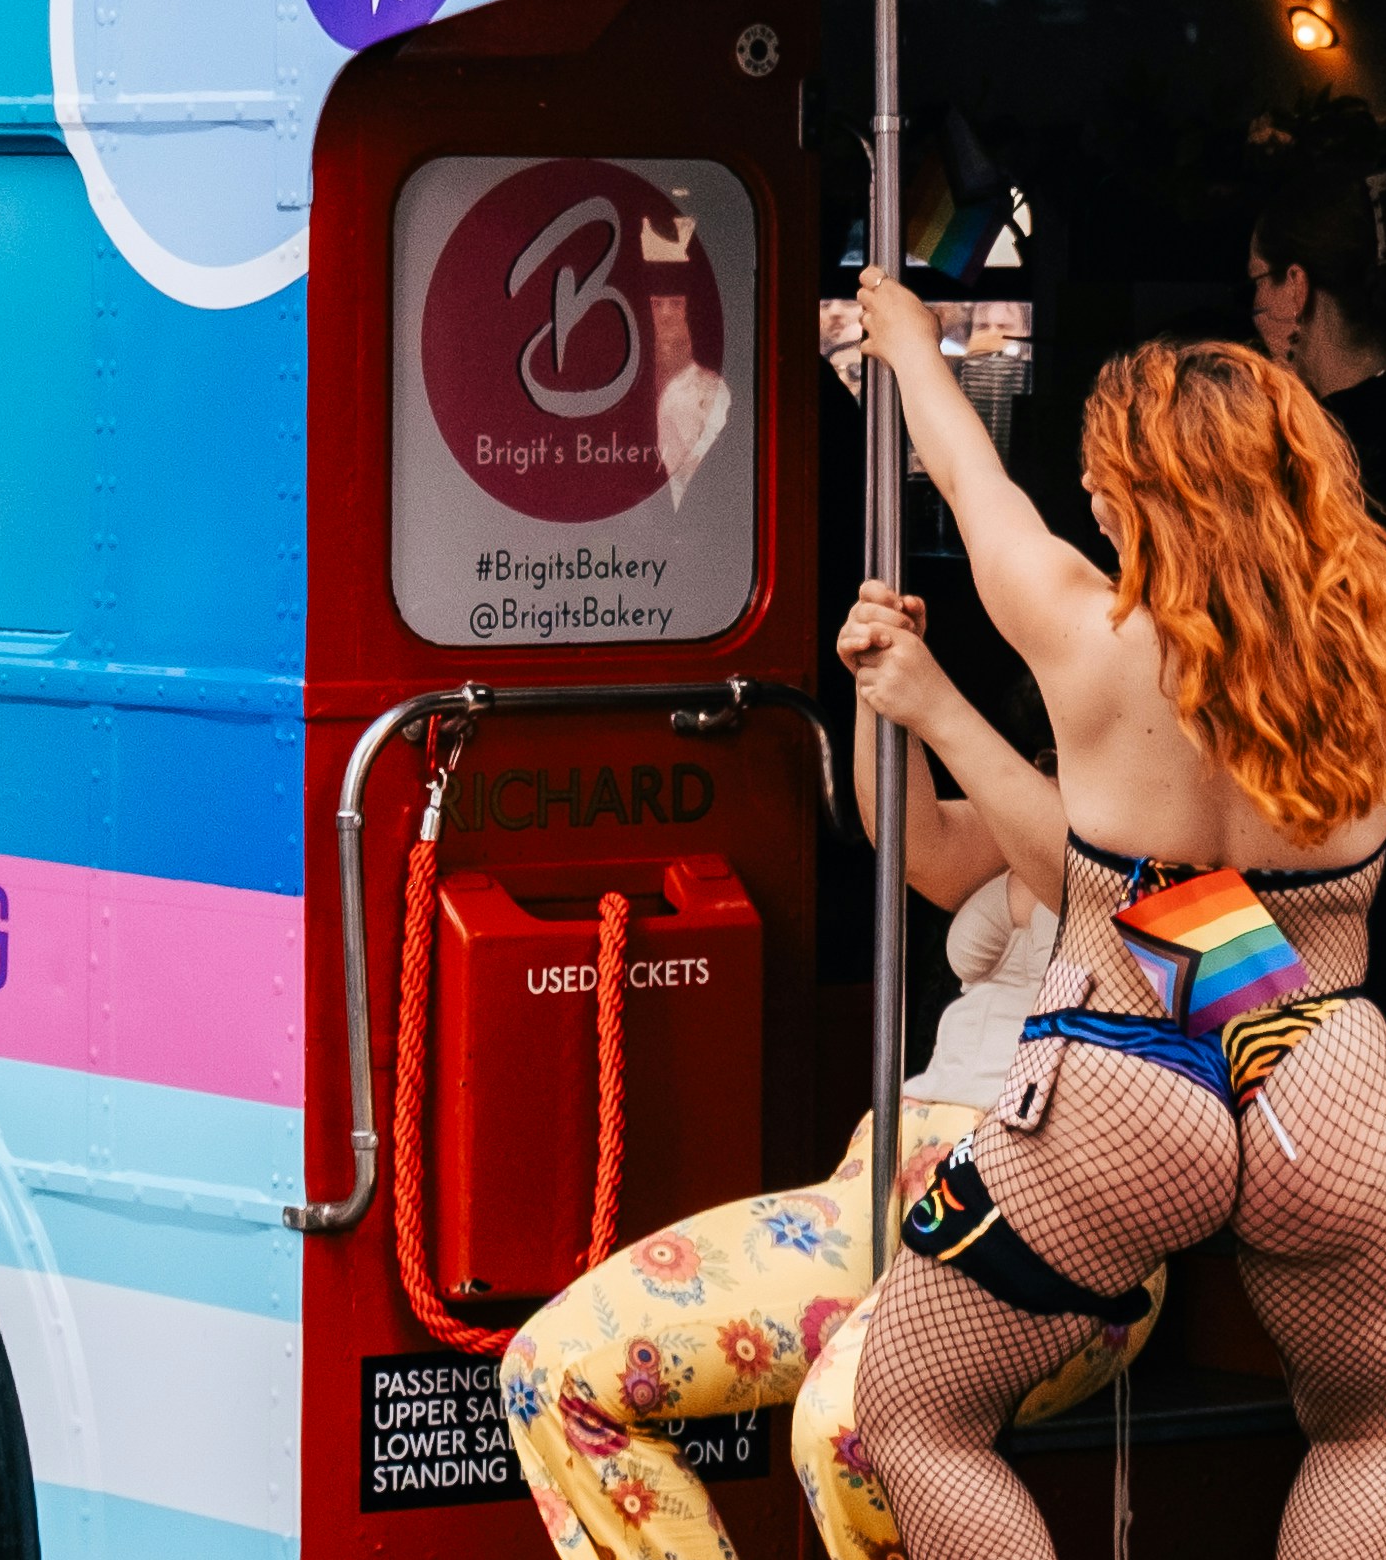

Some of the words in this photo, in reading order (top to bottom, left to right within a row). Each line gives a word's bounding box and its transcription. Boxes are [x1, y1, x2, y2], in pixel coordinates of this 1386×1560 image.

[476, 433, 564, 476] Brigit's
[576, 431, 669, 474] Bakery
[475, 544, 668, 591] #BrigitsBakery
[469, 594, 674, 639] @BrigitsBakery
[526, 964, 598, 995] USED
[373, 1398, 458, 1430] UPPER
[373, 1429, 468, 1462] LOWER
[372, 1455, 508, 1494] STANDING
